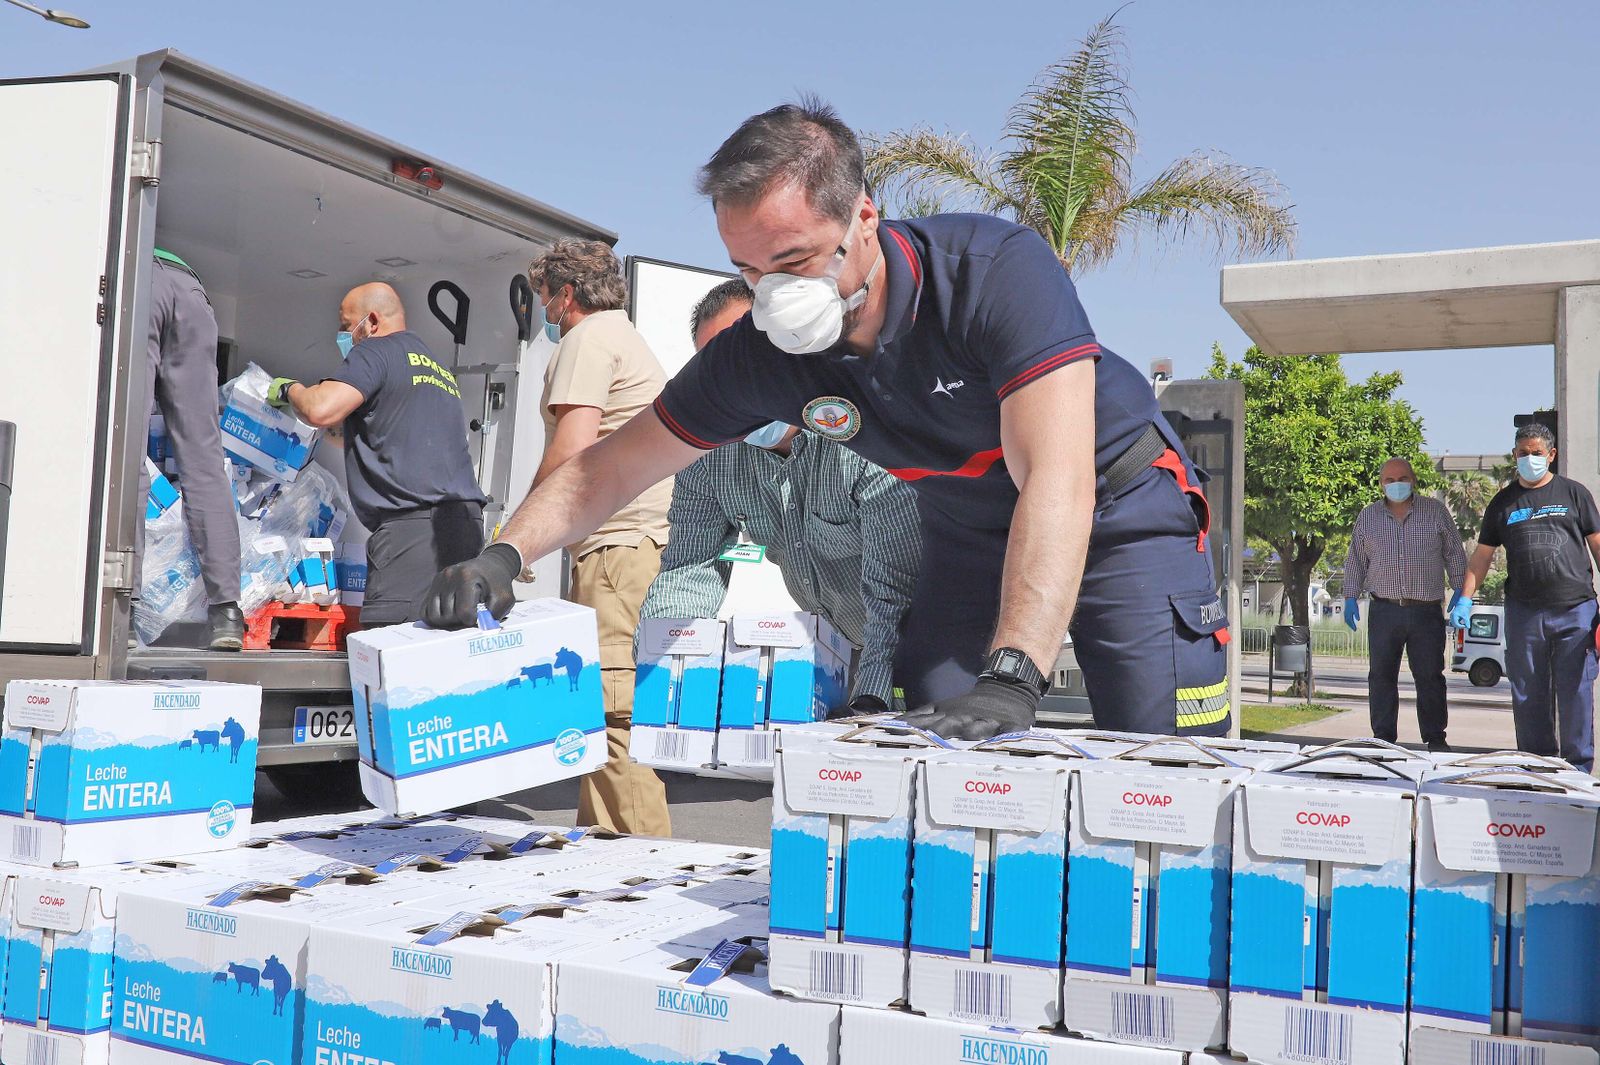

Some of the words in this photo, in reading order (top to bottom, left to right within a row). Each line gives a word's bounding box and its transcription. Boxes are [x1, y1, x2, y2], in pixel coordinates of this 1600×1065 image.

[223, 413, 245, 426] Leche
[224, 419, 261, 447] ENTERA
[347, 578, 367, 589] ENTE
[669, 629, 695, 637] COVAP
[758, 621, 786, 629] COVAP
[469, 632, 523, 654] HACENDADO
[153, 693, 200, 708] HACENDADO
[297, 729, 304, 737] E
[311, 710, 354, 739] 062
[407, 714, 452, 737] Leche
[408, 721, 509, 765] ENTERA
[86, 763, 127, 781] Leche
[819, 769, 862, 782] COVAP
[83, 781, 172, 811] ENTERA
[965, 781, 1011, 795] COVAP
[1123, 792, 1173, 807] COVAP
[1296, 812, 1351, 827] COVAP
[1487, 823, 1545, 838] COVAP
[39, 895, 65, 907] COVAP
[187, 911, 237, 935] HACENDADO
[392, 950, 452, 977] HACENDADO
[125, 976, 161, 1001] Leche
[657, 988, 728, 1019] HACENDADO
[122, 1000, 206, 1045] ENTERA
[316, 1020, 361, 1049] Leche
[962, 1039, 1048, 1065] HACENDADO
